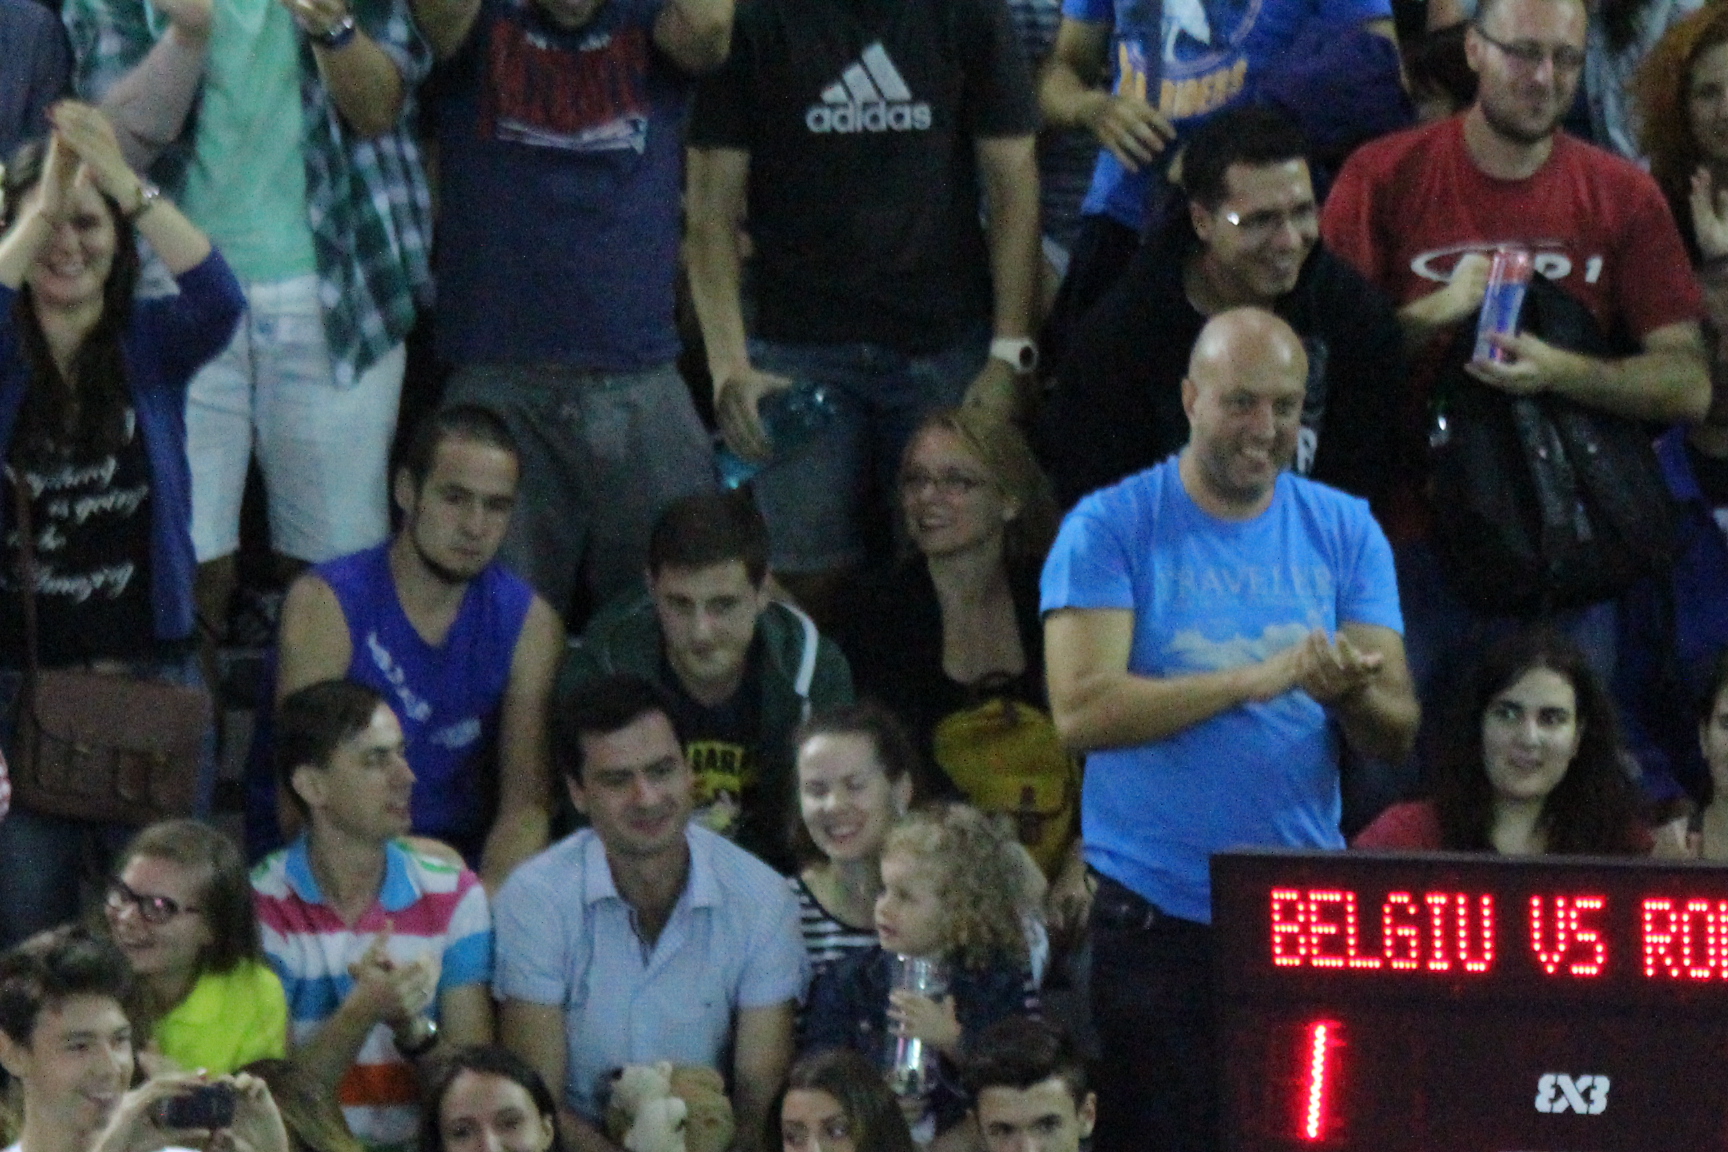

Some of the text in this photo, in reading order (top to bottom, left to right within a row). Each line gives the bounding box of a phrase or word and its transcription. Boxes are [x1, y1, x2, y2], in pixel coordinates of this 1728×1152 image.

[806, 100, 932, 133] adidas
[1271, 888, 1494, 973] BELGIU
[1530, 895, 1606, 975] VS
